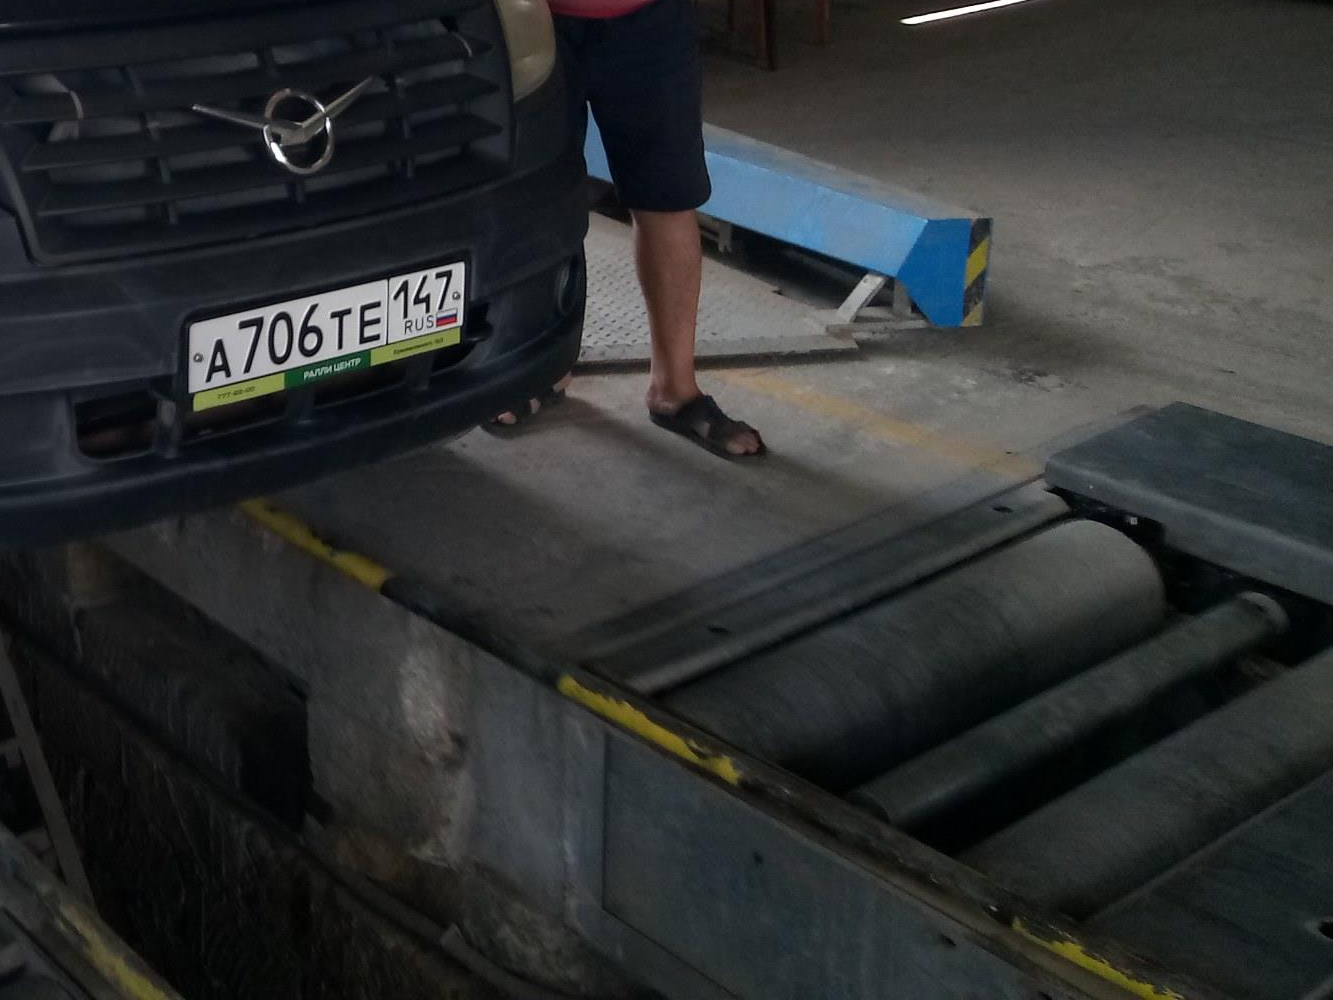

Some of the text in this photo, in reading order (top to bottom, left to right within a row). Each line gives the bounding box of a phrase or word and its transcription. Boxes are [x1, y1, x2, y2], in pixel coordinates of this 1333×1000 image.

[392, 269, 453, 319] 147
[404, 315, 434, 334] RUS
[303, 357, 362, 381] РАЛЛИ ЦЕНТР
